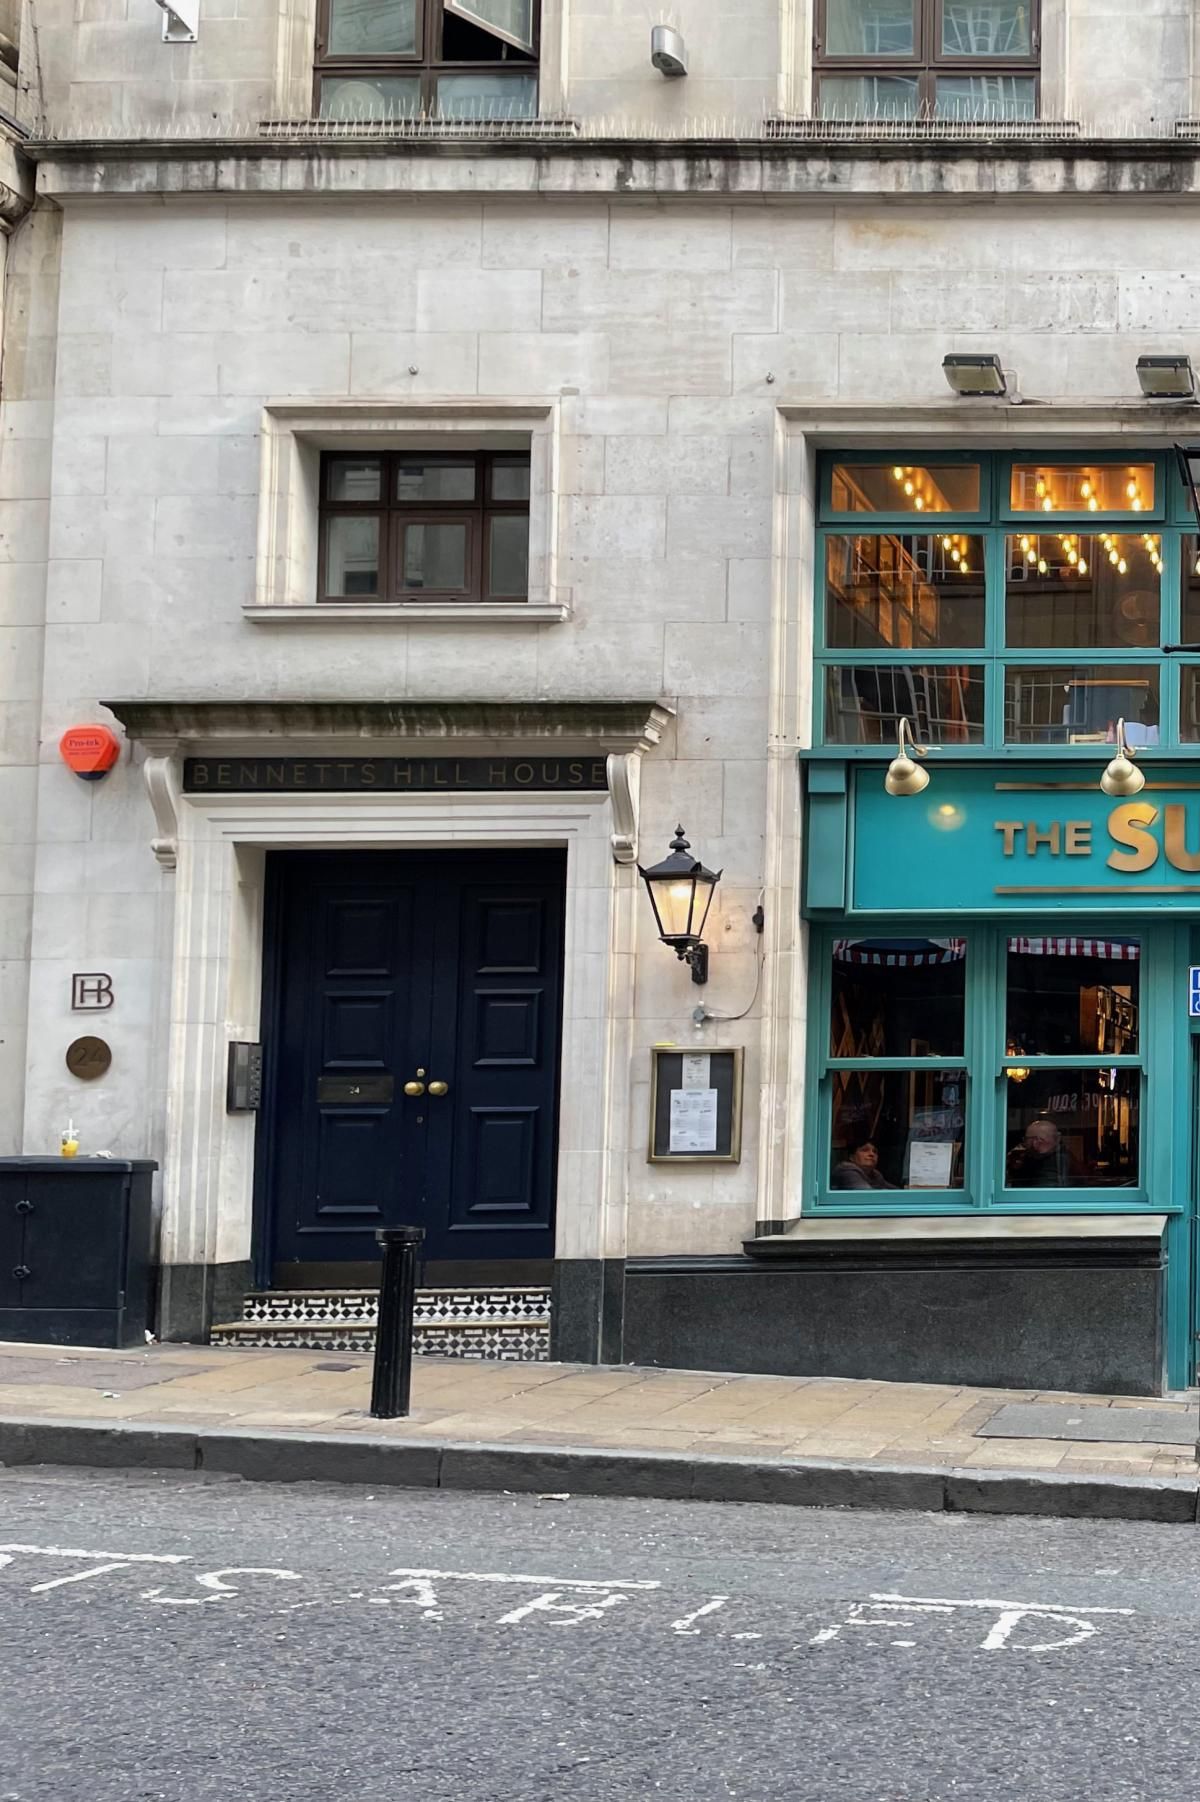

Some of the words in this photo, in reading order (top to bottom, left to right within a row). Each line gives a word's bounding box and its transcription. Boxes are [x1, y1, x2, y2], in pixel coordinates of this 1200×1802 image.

[192, 763, 376, 785] BENNETTS
[393, 763, 469, 785] HILL
[488, 762, 605, 784] HOUSE
[994, 821, 1092, 855] THE
[72, 1046, 105, 1066] 24
